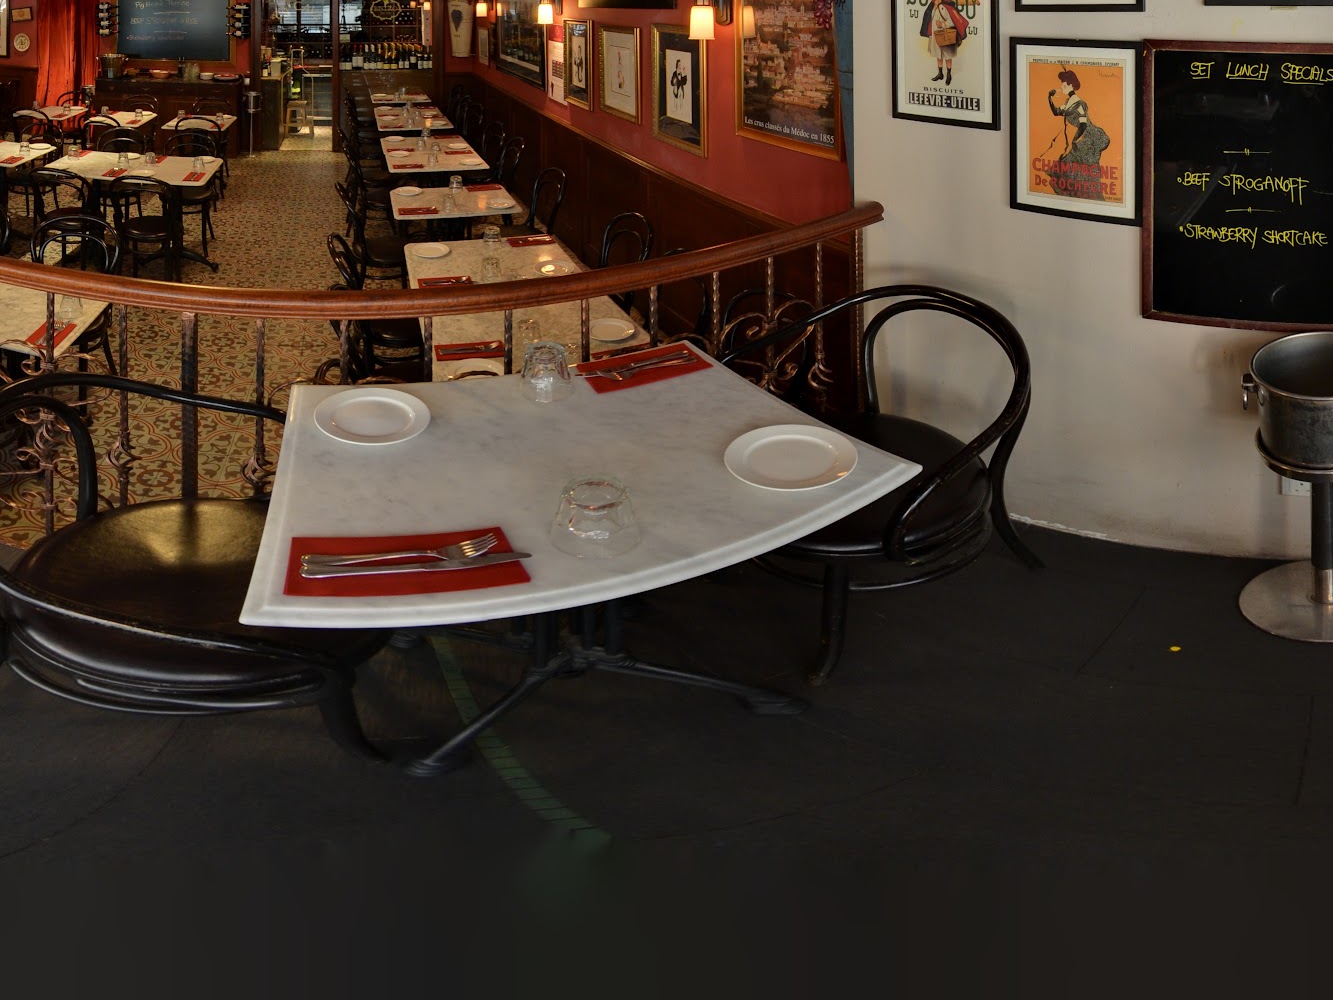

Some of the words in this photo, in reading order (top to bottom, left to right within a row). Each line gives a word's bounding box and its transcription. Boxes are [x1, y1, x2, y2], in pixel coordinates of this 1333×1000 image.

[910, 9, 919, 19] LU
[968, 26, 978, 36] LU
[1190, 62, 1215, 78] SET
[1226, 62, 1269, 80] LUNCH
[1281, 63, 1333, 82] SPECIALS
[924, 86, 964, 94] BISCUITS
[744, 116, 753, 125] Les
[765, 121, 782, 132] classés
[782, 125, 790, 134] du
[790, 126, 810, 139] Médoc
[811, 132, 818, 141] en
[819, 133, 834, 144] 1855
[1032, 158, 1118, 180] CHAMPAGNE
[1034, 174, 1049, 186] De
[1182, 172, 1210, 192] BEEF
[1218, 174, 1309, 205] STROGANOFF
[1184, 223, 1258, 249] STRAWBERRY
[1262, 230, 1328, 246] SHORTCAKE
